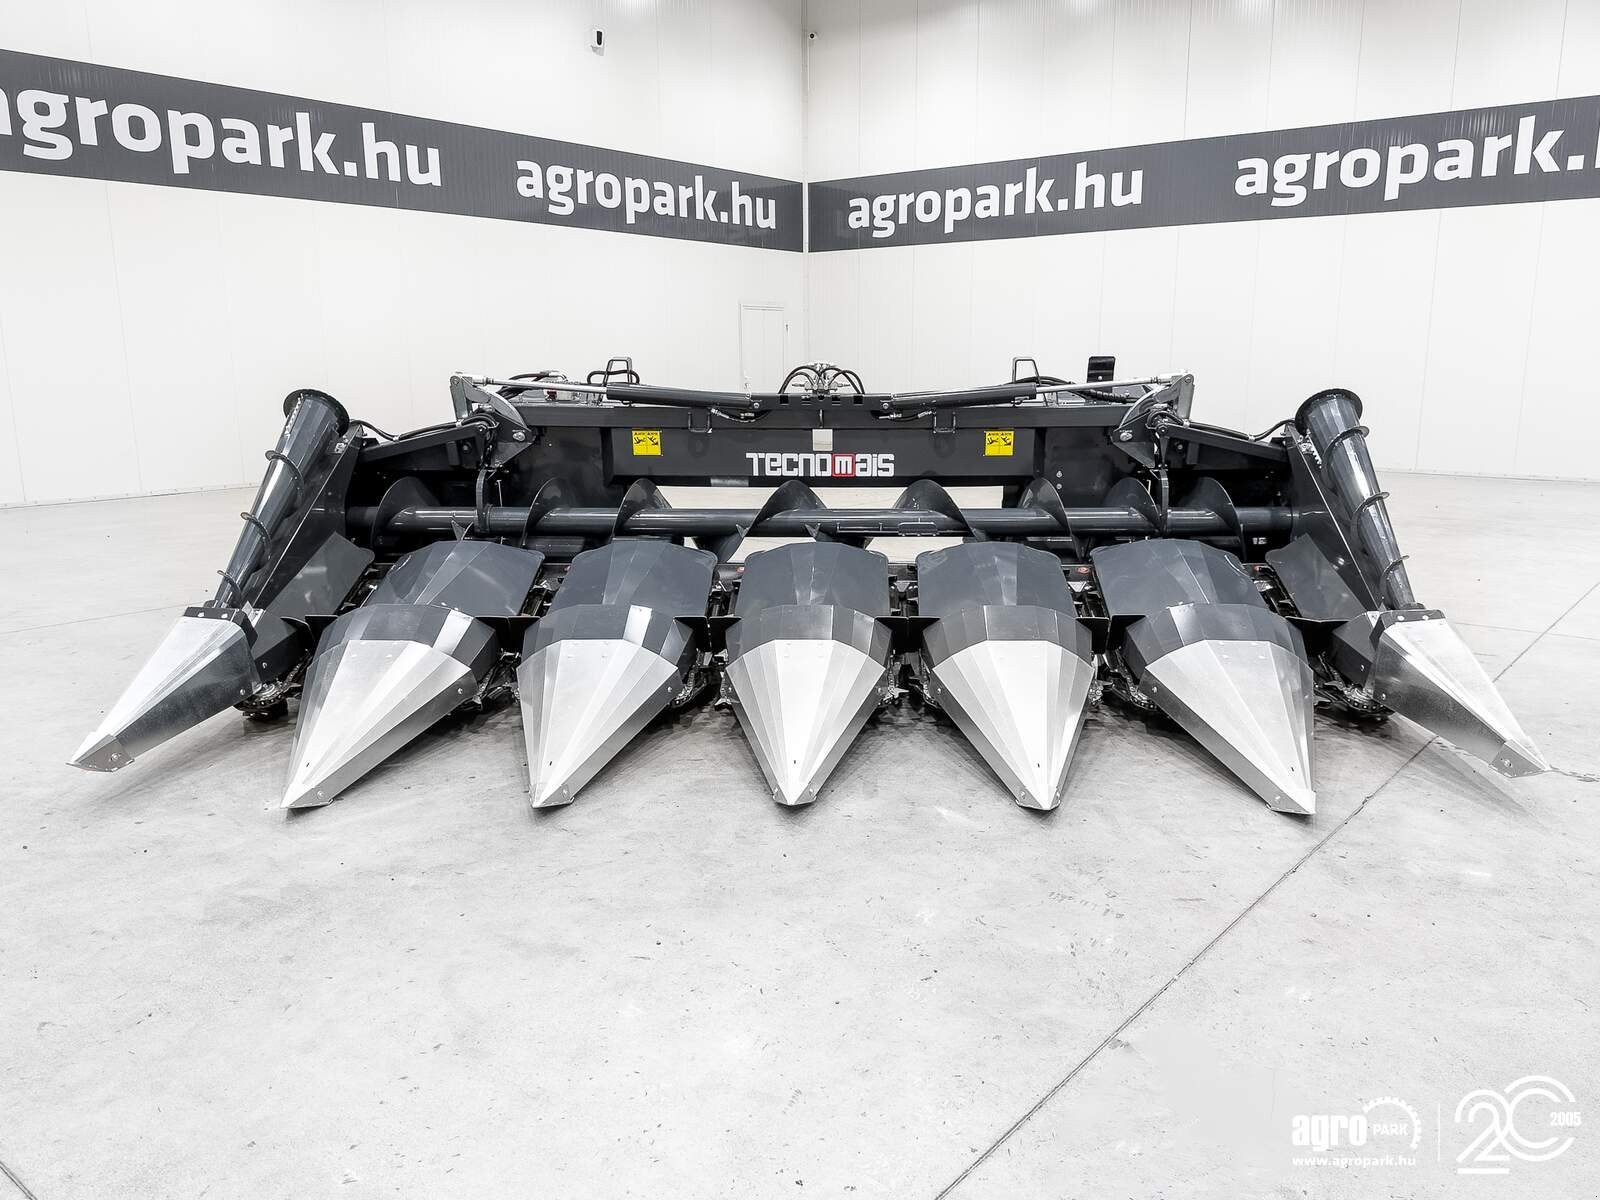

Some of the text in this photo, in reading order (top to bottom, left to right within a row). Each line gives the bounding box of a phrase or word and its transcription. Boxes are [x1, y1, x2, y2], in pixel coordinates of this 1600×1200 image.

[516, 160, 776, 230] agropark.hu
[1234, 114, 1600, 207] agropark.
[848, 161, 1144, 238] agropark.hu
